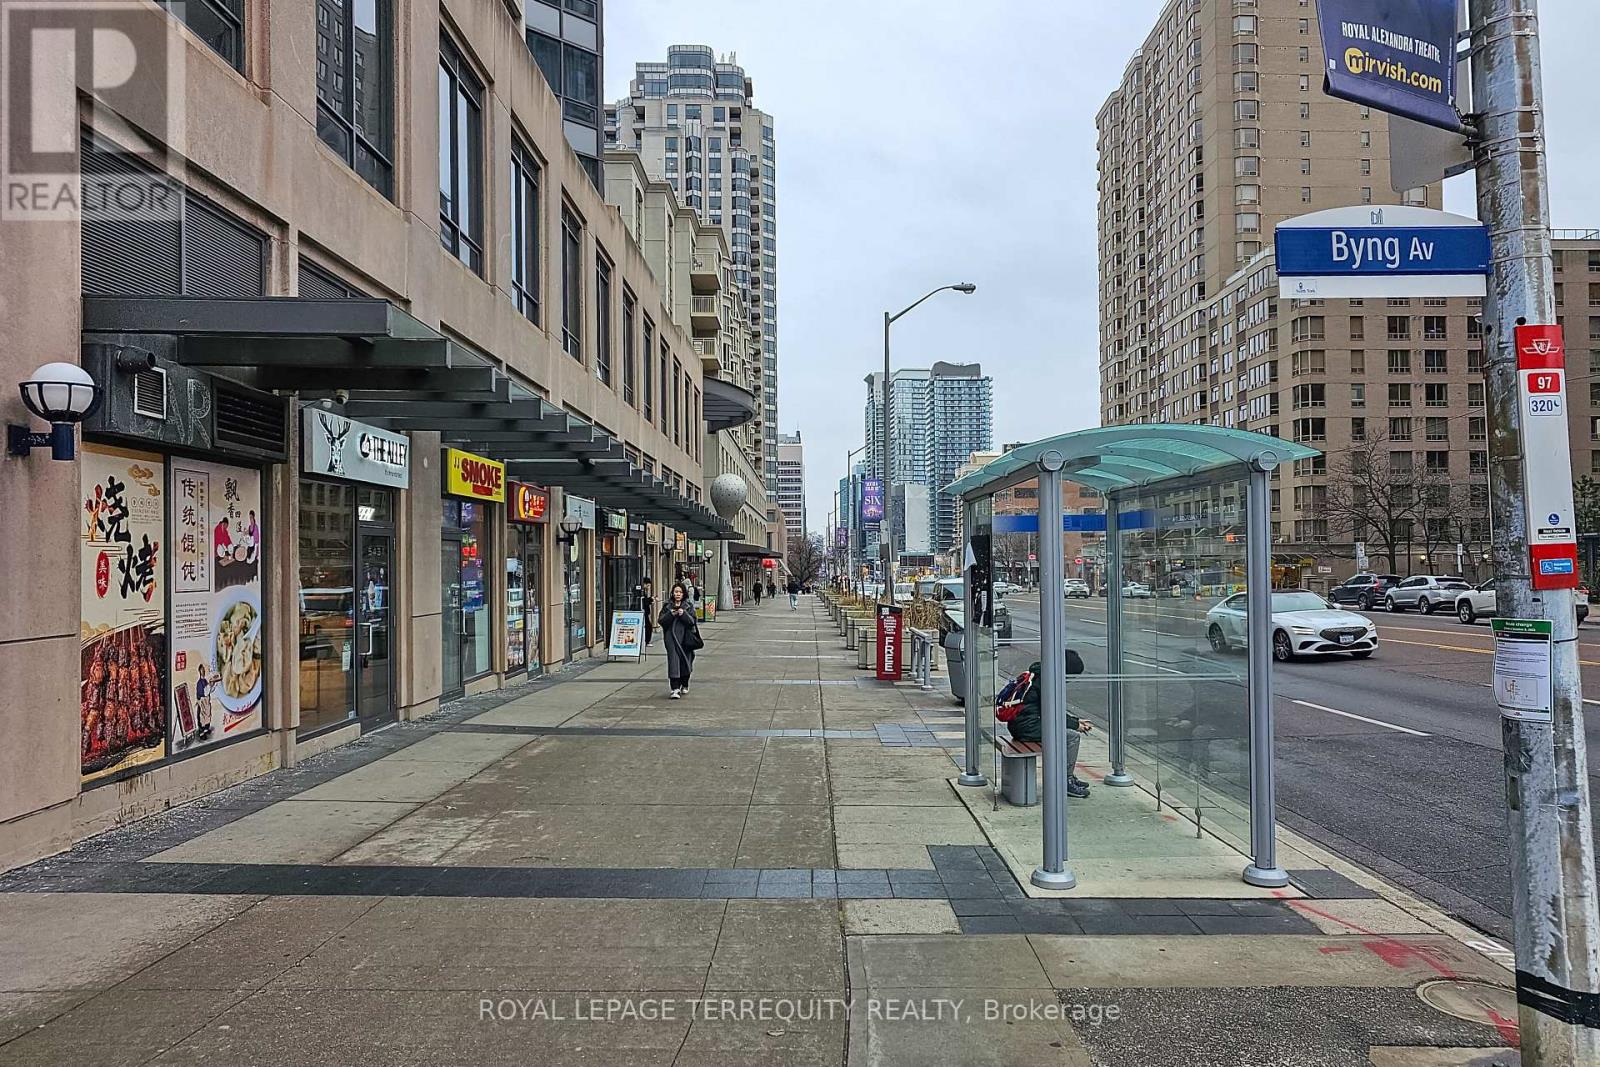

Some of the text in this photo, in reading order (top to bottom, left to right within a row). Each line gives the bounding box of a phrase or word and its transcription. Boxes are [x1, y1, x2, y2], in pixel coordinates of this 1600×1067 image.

[1342, 21, 1441, 65] ROYAL ALEXANDRA THEATR
[1345, 48, 1442, 94] mirvish.com
[1331, 230, 1434, 269] Byng Av
[1538, 376, 1552, 389] 97
[1531, 400, 1553, 412] 320
[372, 435, 407, 468] THE ALLEY
[461, 457, 502, 489] SMOKE
[864, 495, 881, 506] SIX
[85, 475, 159, 603] 烧烤
[181, 477, 196, 582] 传统馄饨
[98, 559, 108, 589] 美味
[885, 636, 894, 672] FREE
